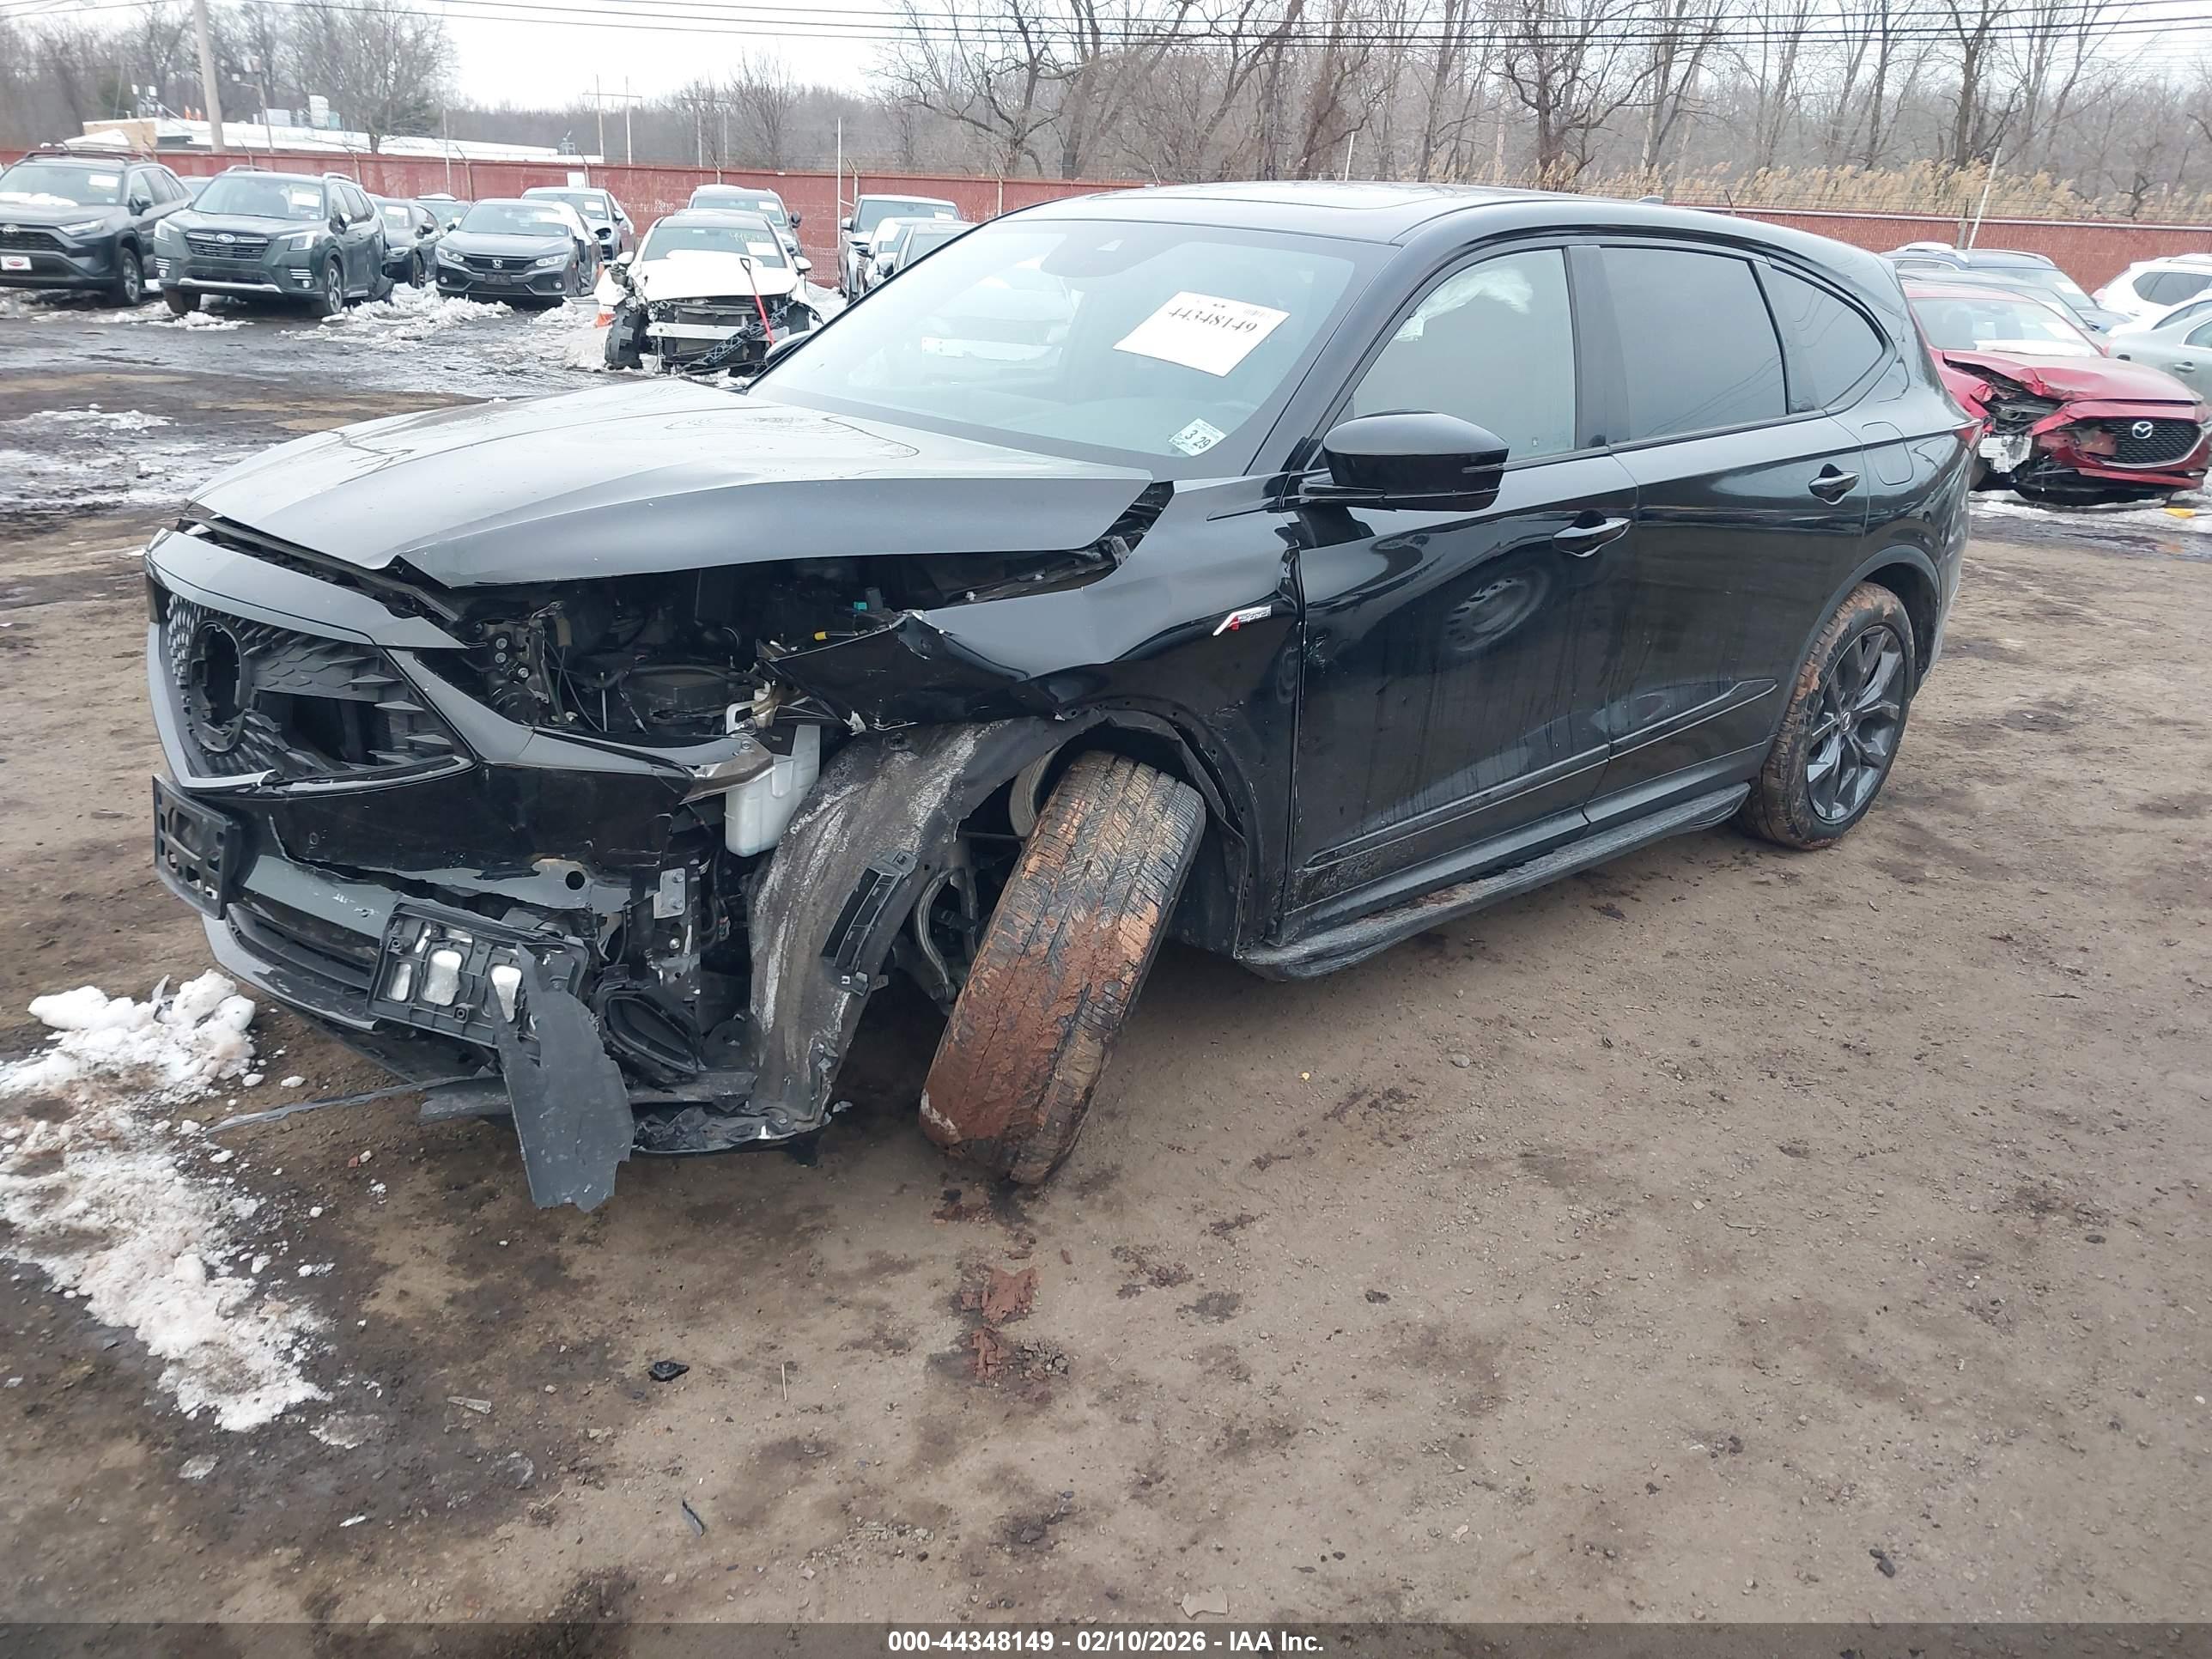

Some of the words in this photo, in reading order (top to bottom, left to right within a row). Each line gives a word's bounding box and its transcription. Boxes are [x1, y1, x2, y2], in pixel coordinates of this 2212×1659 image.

[1168, 307, 1258, 333] 44348149
[1185, 429, 1199, 440] 3
[1193, 436, 1212, 449] 29
